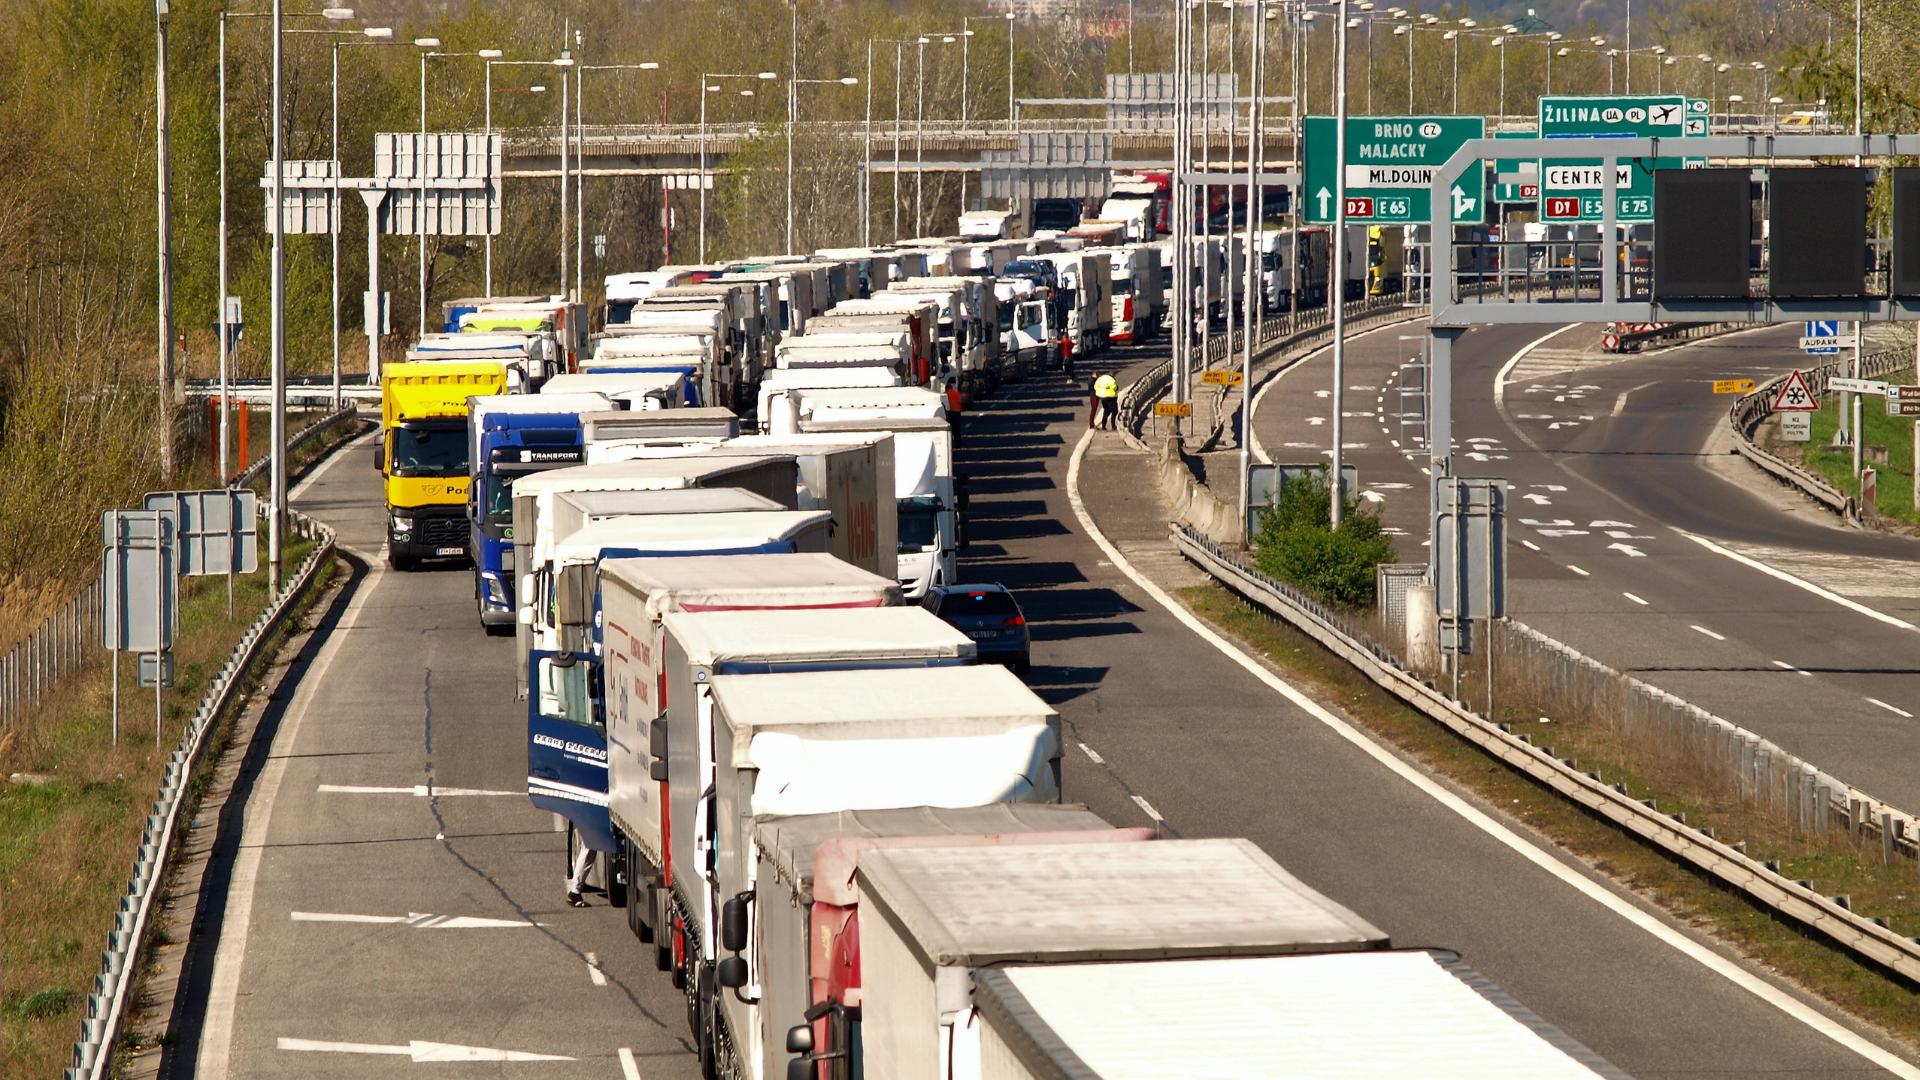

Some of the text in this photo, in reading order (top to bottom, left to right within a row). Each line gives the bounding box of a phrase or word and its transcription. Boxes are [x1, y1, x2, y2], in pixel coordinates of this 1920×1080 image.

[1545, 105, 1640, 123] ŽILINA UA PL
[1375, 124, 1437, 138] BRNO CZ
[1360, 144, 1427, 158] MALACKY
[1369, 169, 1432, 184] ML.DOLIN
[1550, 170, 1628, 185] CENTRM
[1524, 186, 1537, 196] D2
[1389, 202, 1407, 215] 65
[1554, 200, 1571, 214] D1
[1622, 201, 1631, 213] E
[1633, 200, 1649, 213] 75
[1804, 339, 1838, 347] AUPARK
